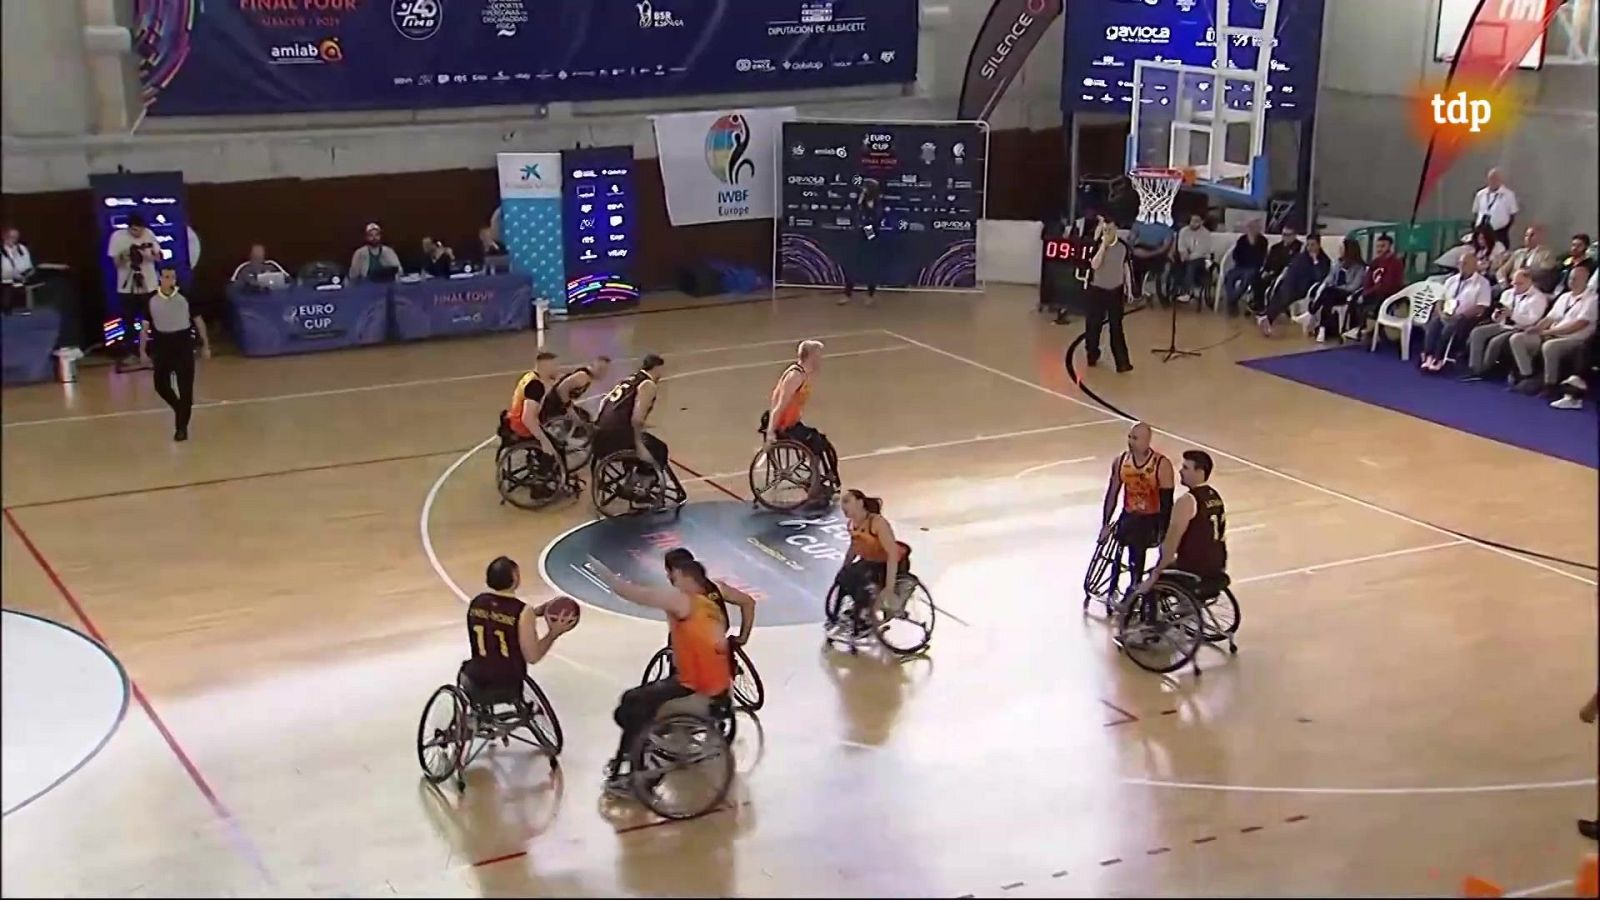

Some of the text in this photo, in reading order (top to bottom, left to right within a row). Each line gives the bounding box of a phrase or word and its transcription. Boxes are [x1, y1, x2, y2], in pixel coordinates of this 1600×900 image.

[869, 134, 892, 142] EURO
[871, 142, 890, 151] CUP
[718, 189, 750, 204] IWBF
[718, 206, 750, 218] Europe
[299, 303, 334, 316] EURO
[304, 317, 332, 330] CUP
[473, 624, 510, 658] 11
